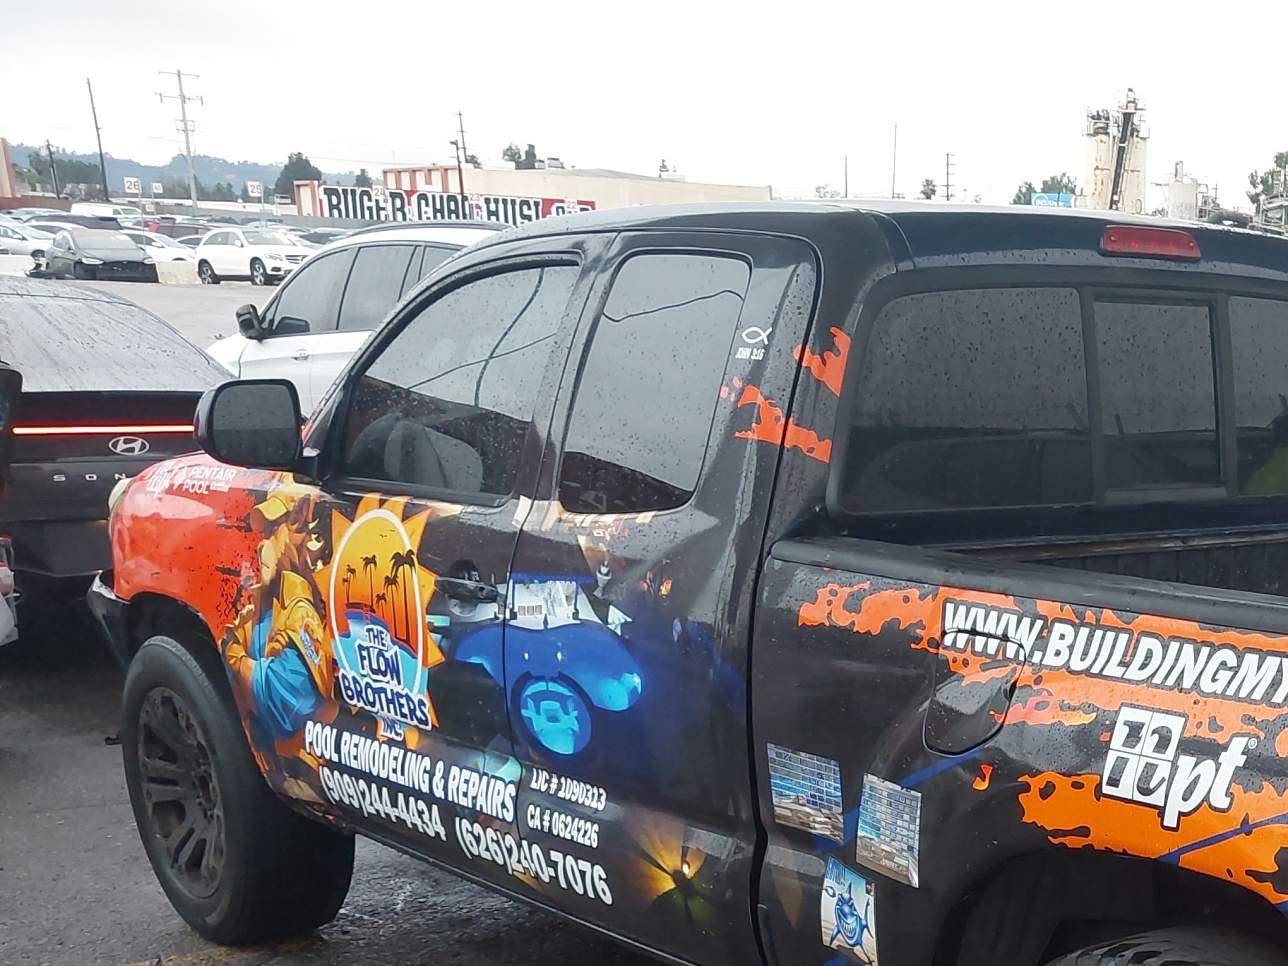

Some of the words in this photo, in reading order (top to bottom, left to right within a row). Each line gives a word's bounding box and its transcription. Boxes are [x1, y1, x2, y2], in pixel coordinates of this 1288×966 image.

[126, 179, 140, 191] 26
[182, 479, 210, 495] POOL
[190, 466, 238, 482] PENTAIR
[365, 627, 387, 649] THE
[356, 643, 402, 687] FLOW
[340, 672, 431, 728] BROTHERS
[304, 720, 339, 763] POOL
[340, 731, 431, 794] REMODELING
[432, 760, 446, 800] &
[448, 765, 516, 823] REPAIRS
[530, 767, 550, 792] LIC
[549, 773, 559, 795] #
[318, 765, 448, 841] (909)244-4434
[527, 804, 541, 831] CA
[543, 809, 551, 833] #
[552, 811, 600, 848] 0624226
[454, 816, 613, 905] (626)240-7076
